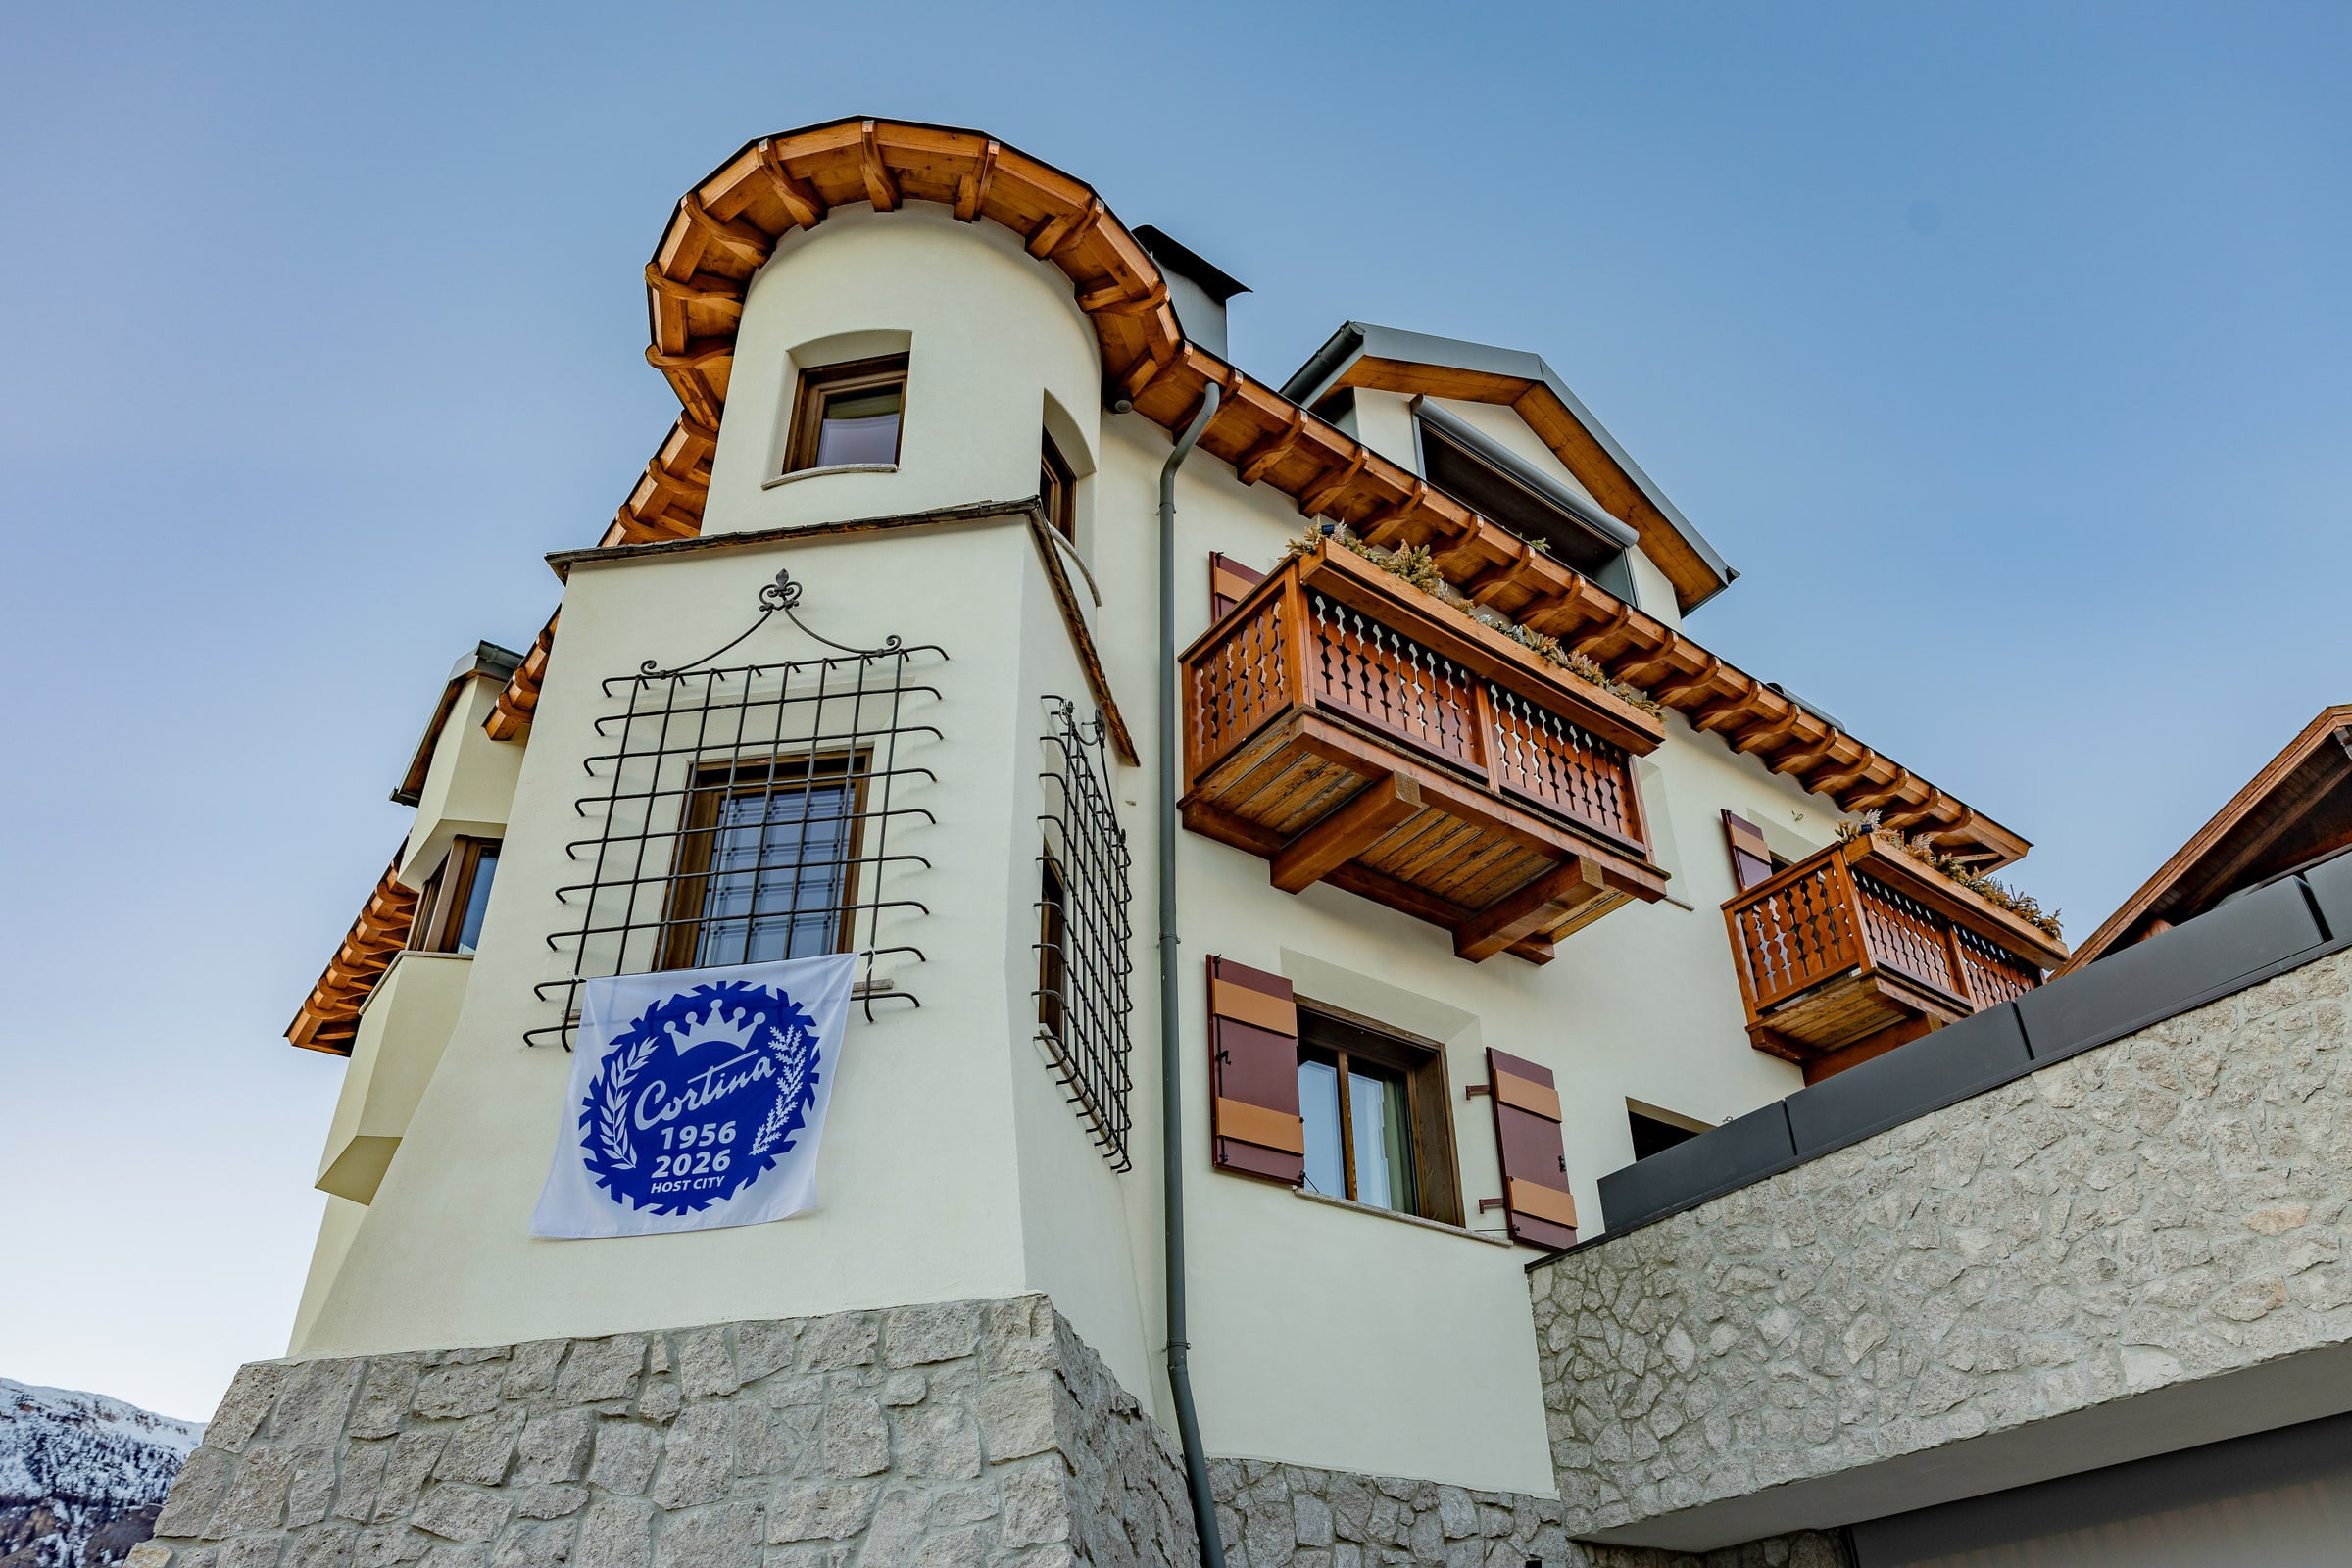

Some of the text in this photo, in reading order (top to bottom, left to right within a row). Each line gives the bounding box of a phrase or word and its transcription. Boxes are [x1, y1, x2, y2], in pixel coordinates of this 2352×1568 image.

[634, 1049, 776, 1131] Cortina
[661, 1121, 737, 1150] 1956
[651, 1150, 731, 1178] 2026
[651, 1175, 725, 1194] HOST CITY
